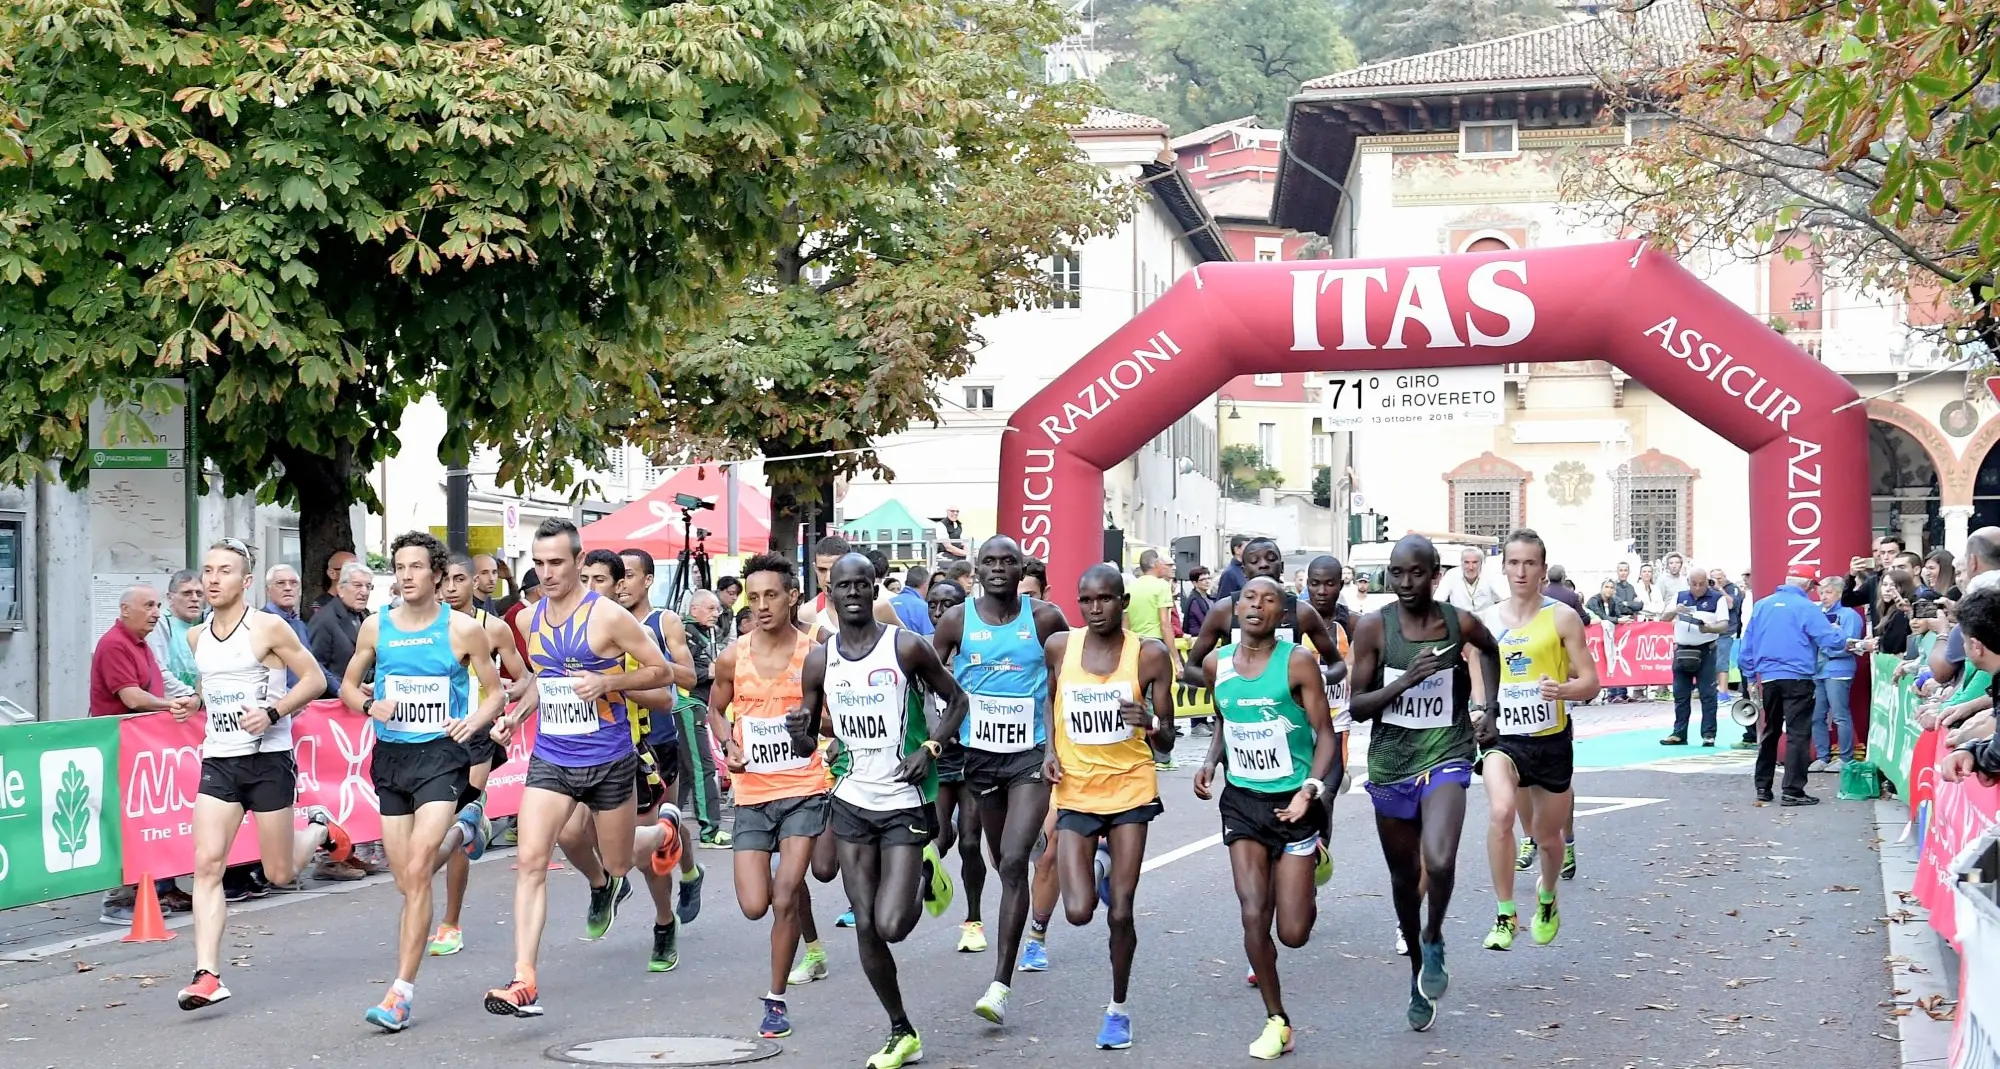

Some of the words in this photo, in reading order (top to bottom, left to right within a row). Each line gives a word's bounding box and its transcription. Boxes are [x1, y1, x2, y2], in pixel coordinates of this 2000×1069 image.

[1290, 260, 1536, 351] ITAS
[1396, 374, 1439, 389] GIRO
[1382, 395, 1395, 408] di
[1402, 391, 1496, 407] ROVERETO
[1372, 416, 1382, 424] 13
[1385, 414, 1423, 424] ottobre
[1429, 413, 1454, 421] 2018
[389, 637, 434, 648] DIADORA
[394, 680, 440, 695] TRENTINO
[208, 691, 245, 705] TRENTINO
[836, 691, 885, 707] TRENTINO
[1072, 689, 1121, 704] TRENTINO
[979, 699, 1024, 716] TRENTINO
[1391, 696, 1443, 718] MAIYO
[1503, 702, 1550, 726] PARISI
[749, 721, 787, 736] TRENTIN
[839, 714, 888, 739] KANDA
[1071, 709, 1125, 733] NDIWA
[976, 719, 1026, 744] JAITEH
[1229, 725, 1274, 741] TRENTINO
[1233, 746, 1280, 771] TONGIK
[140, 826, 171, 842] The
